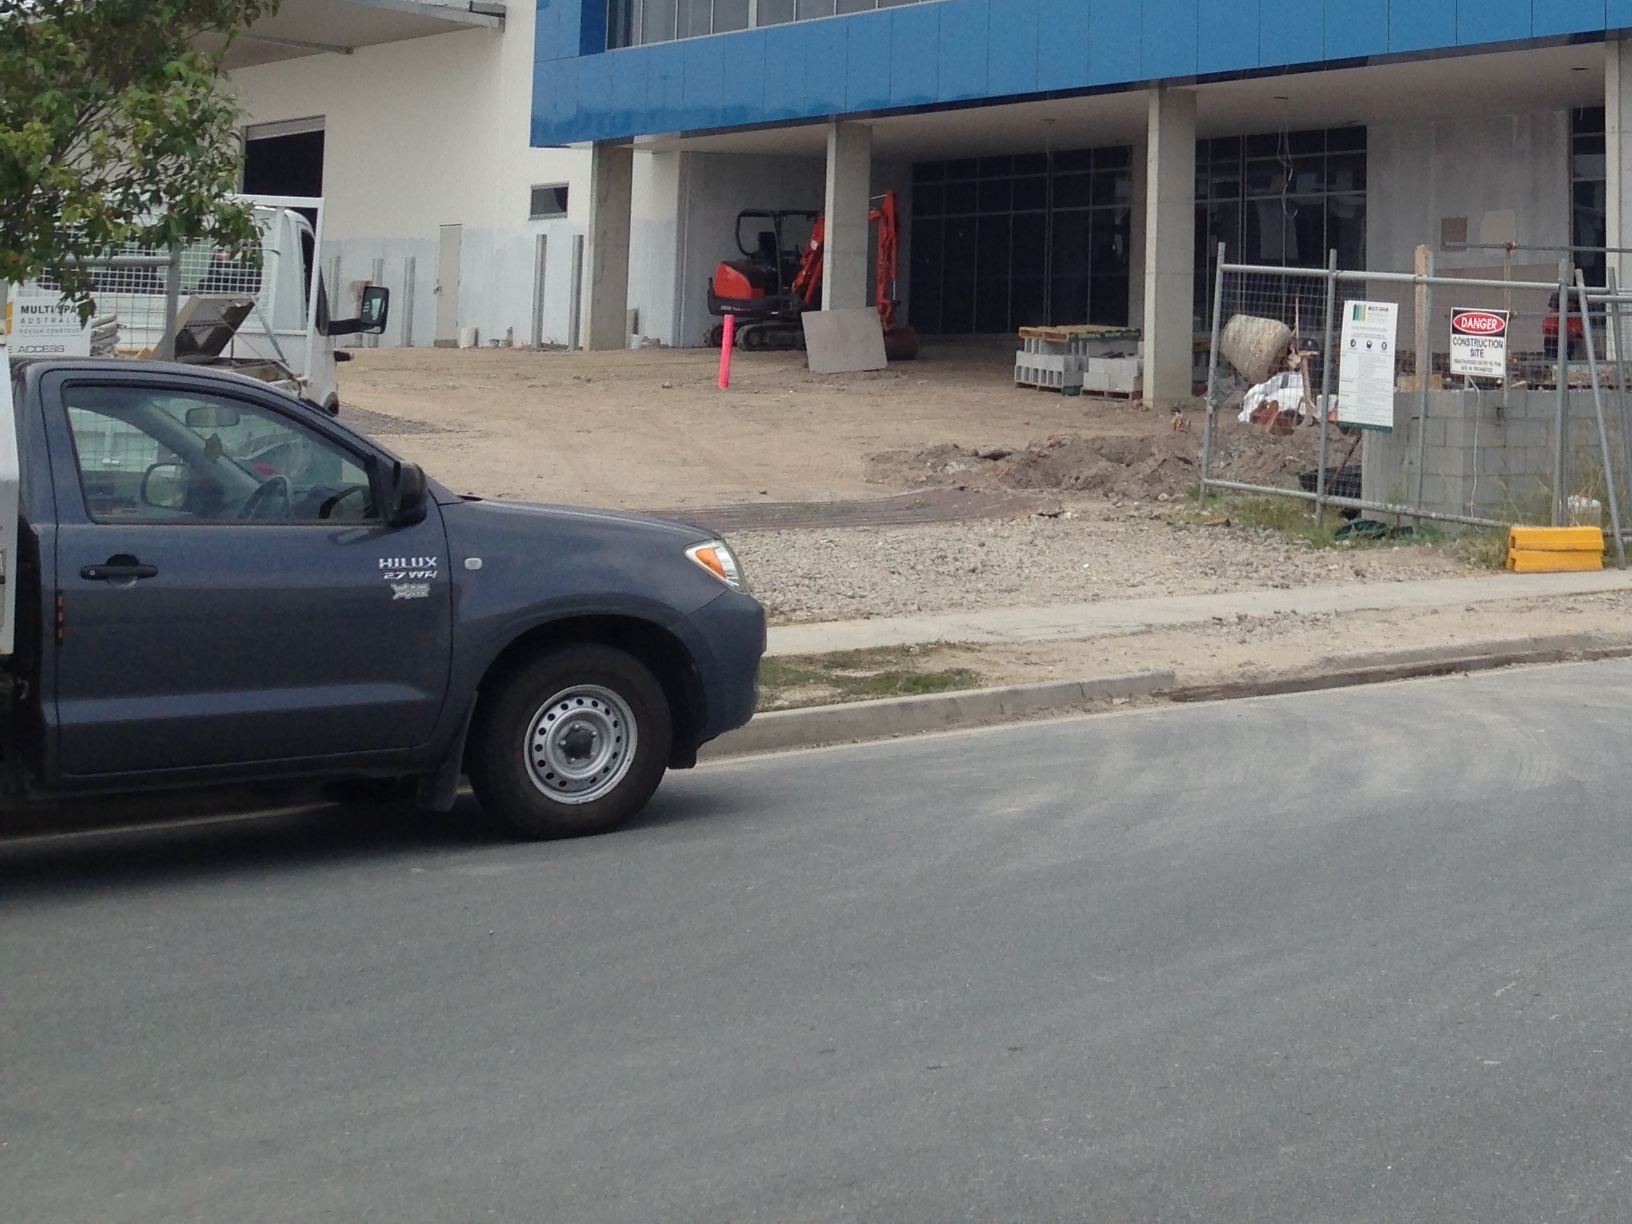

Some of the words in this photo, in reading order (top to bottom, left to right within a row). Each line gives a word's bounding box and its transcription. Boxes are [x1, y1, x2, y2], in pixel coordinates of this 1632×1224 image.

[21, 305, 54, 314] MULTI
[1461, 317, 1498, 331] DANGER
[1453, 337, 1503, 349] CONSTRUCTION
[17, 345, 65, 353] ACCESS
[1470, 348, 1484, 358] SITE
[379, 557, 437, 569] HILUX
